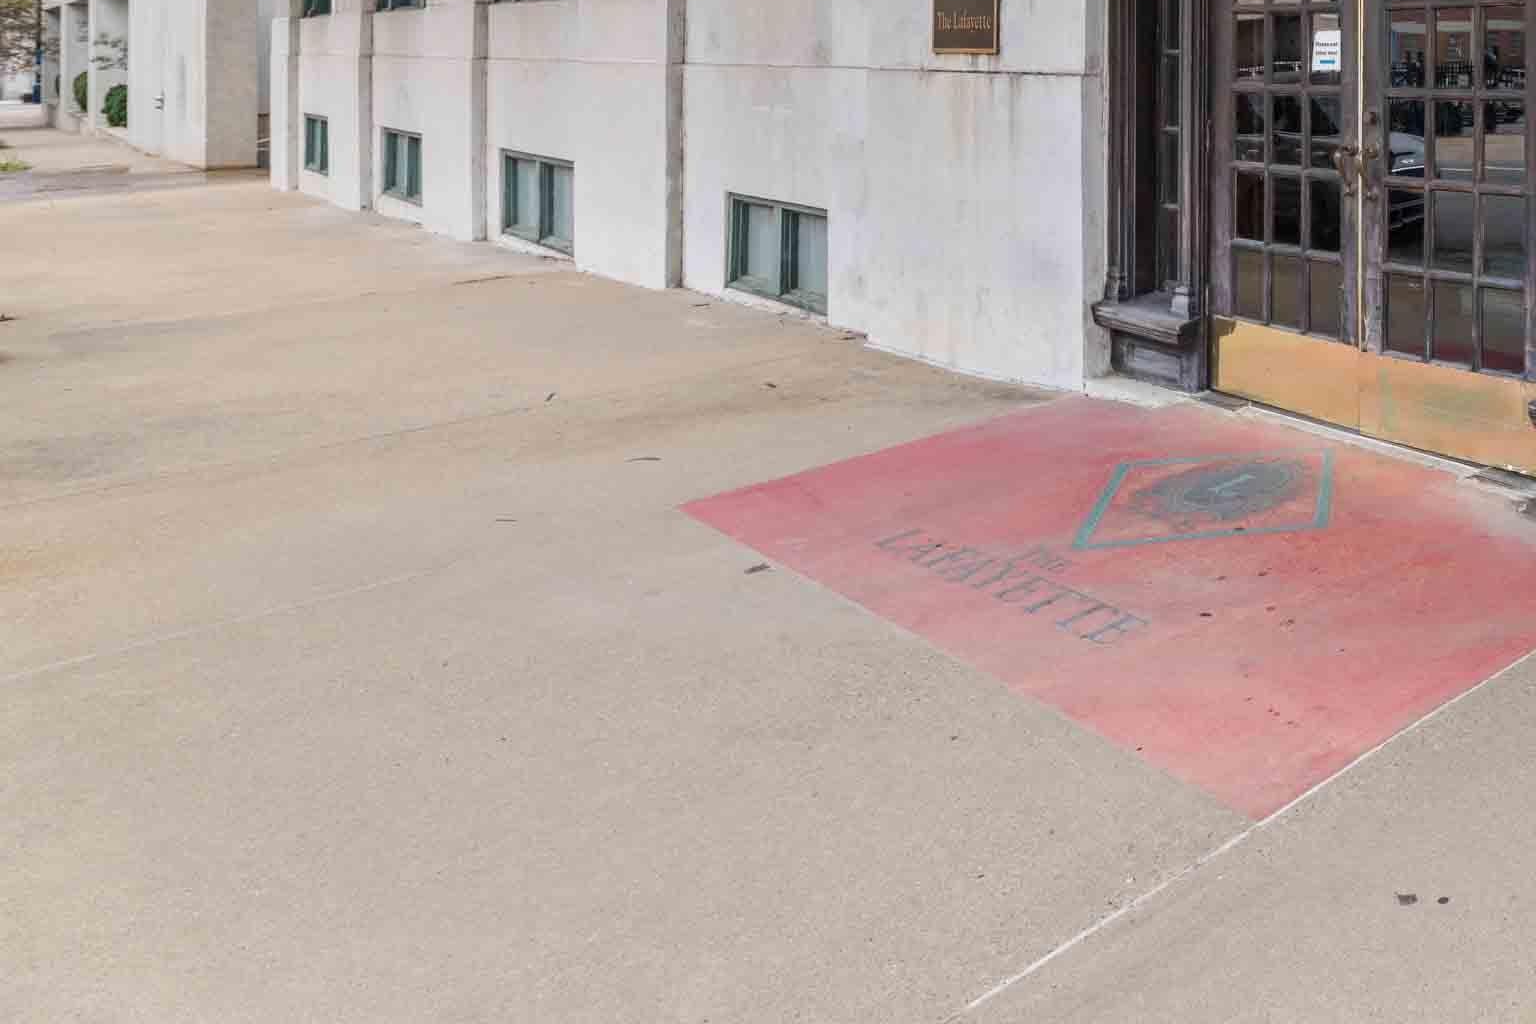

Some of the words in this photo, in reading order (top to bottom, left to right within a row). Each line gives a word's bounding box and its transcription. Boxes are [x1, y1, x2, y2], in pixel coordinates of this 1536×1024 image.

[936, 10, 952, 32] The
[953, 7, 992, 33] Lafayette
[876, 526, 1150, 646] LAFAYETTE
